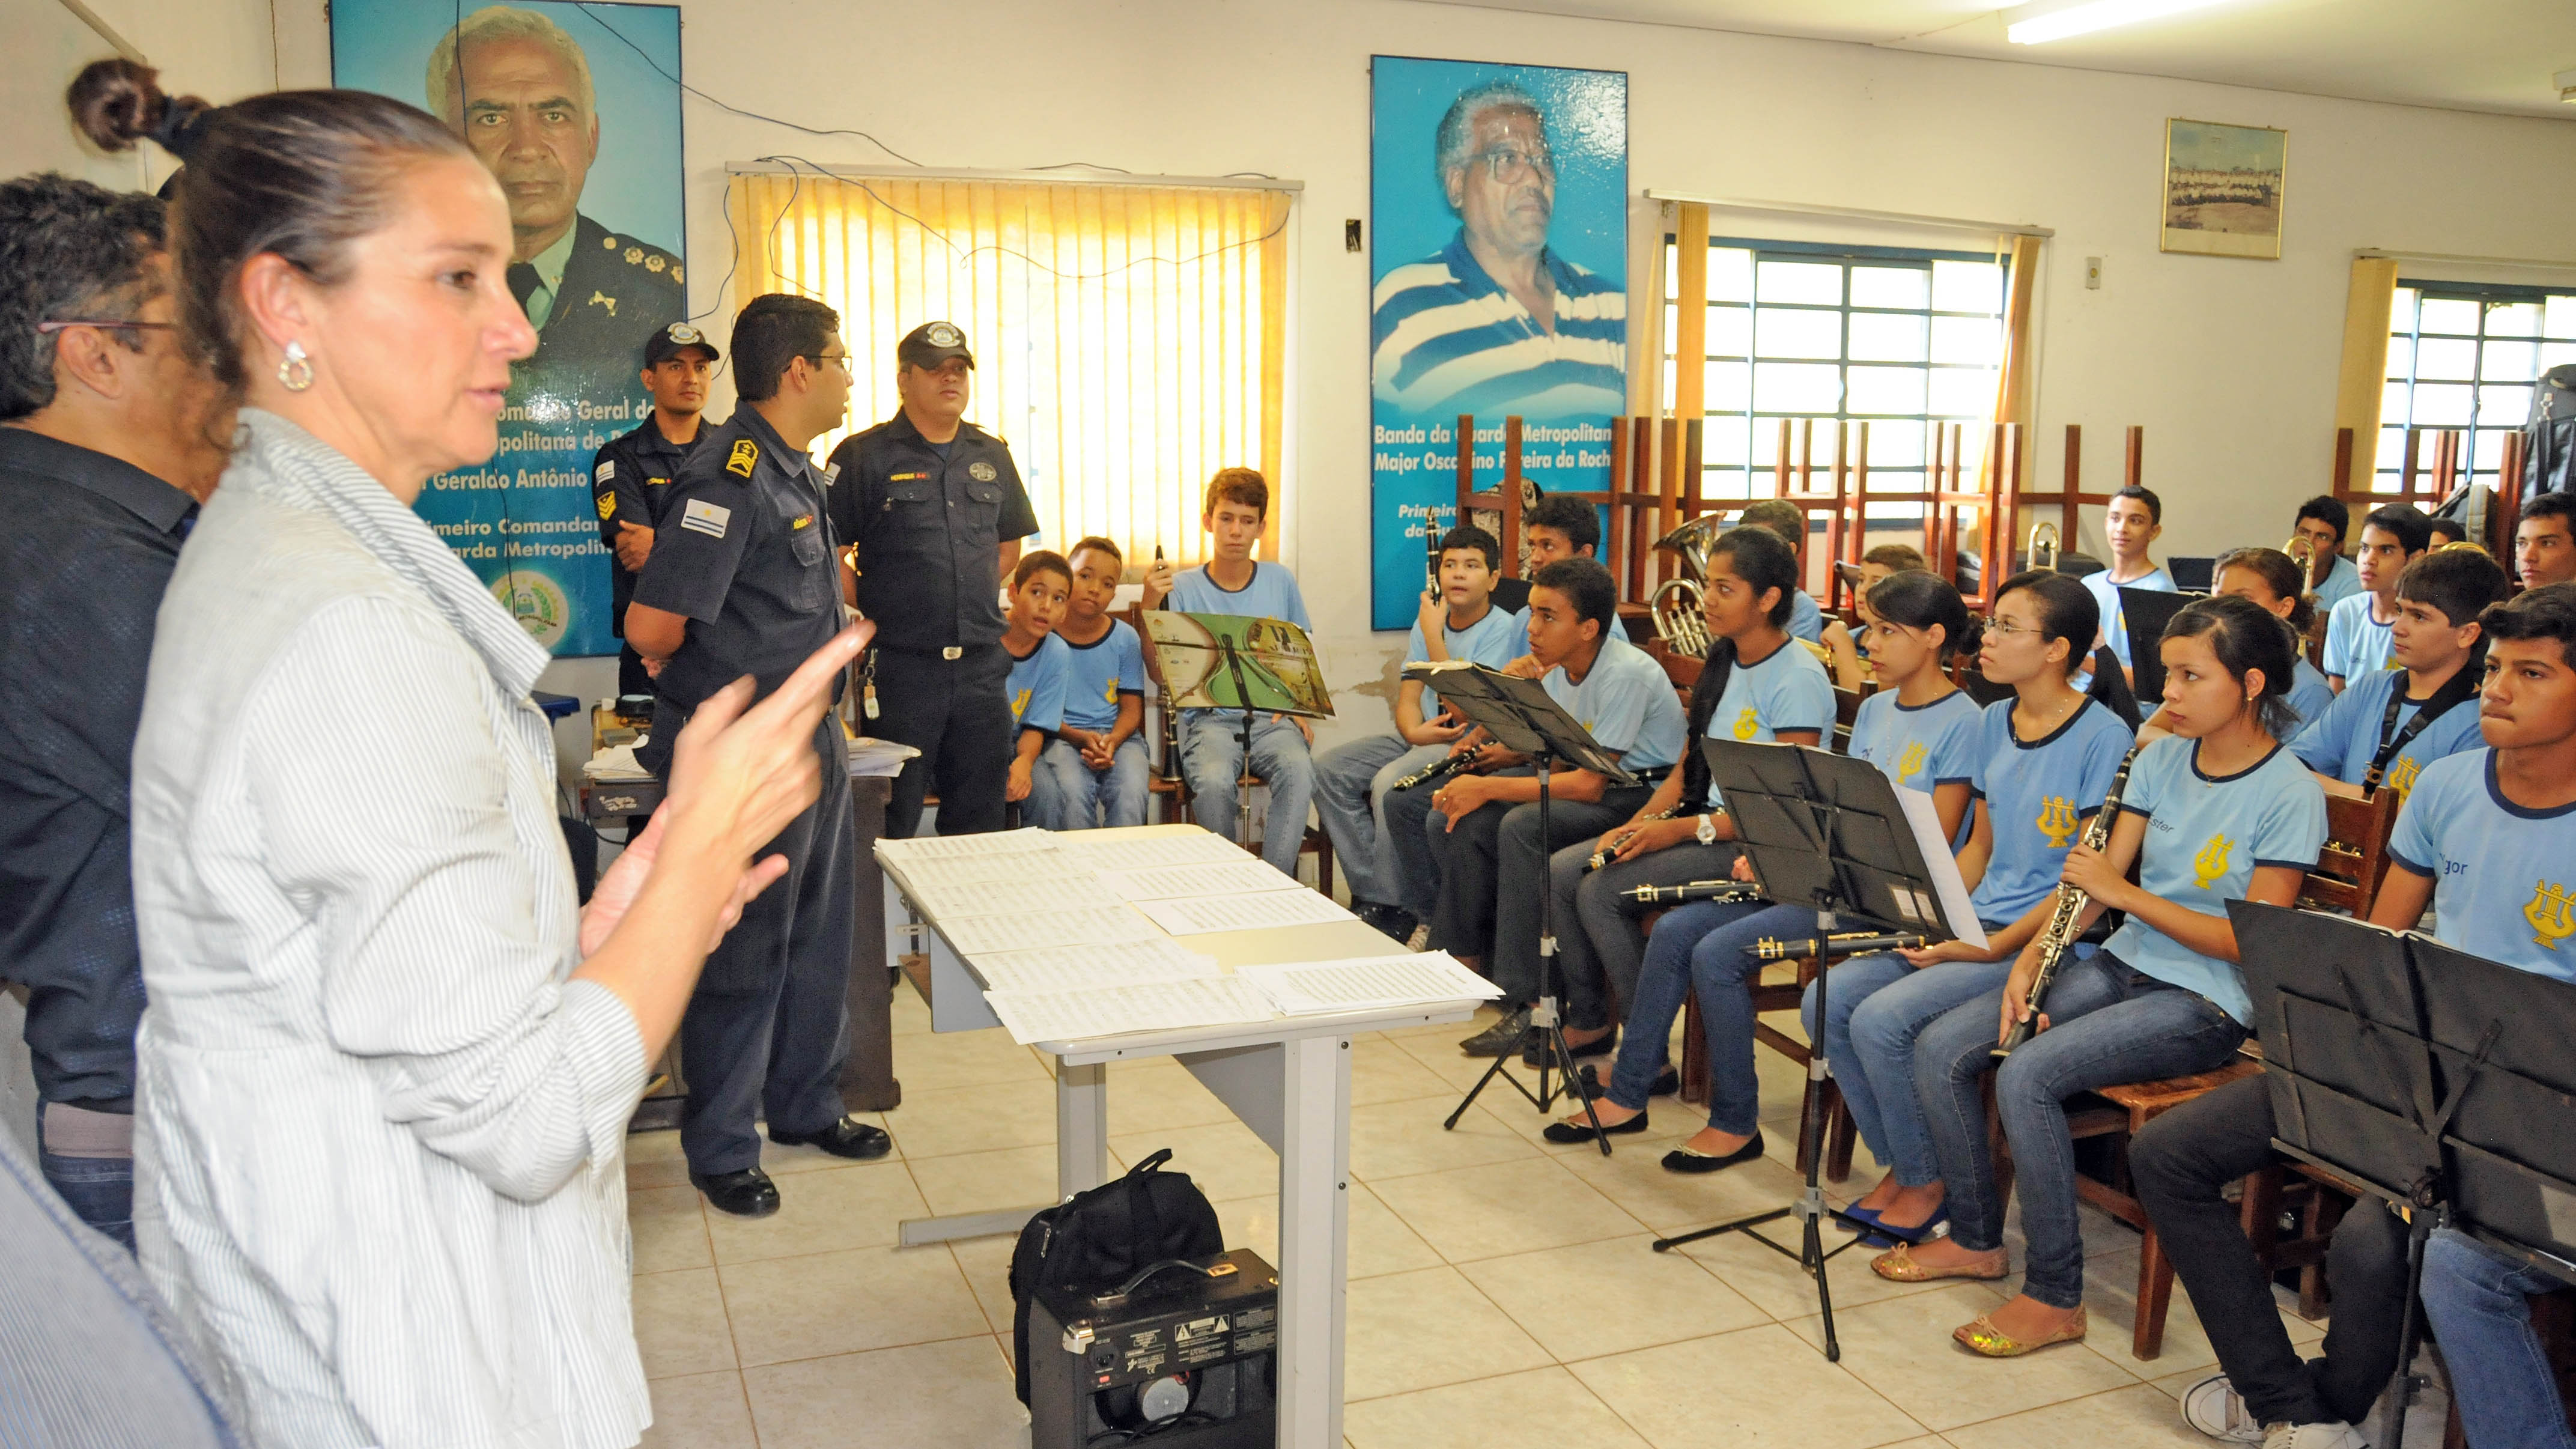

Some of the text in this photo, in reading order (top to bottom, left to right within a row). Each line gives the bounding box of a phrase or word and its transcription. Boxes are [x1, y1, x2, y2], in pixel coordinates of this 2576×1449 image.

[579, 399, 630, 420] Geral
[497, 430, 577, 457] politana
[582, 430, 606, 451] de
[1375, 422, 1612, 446] Banda da ard Metropolitan
[1375, 452, 1420, 475] Major
[1556, 450, 1575, 468] da
[1578, 449, 1611, 467] Roch
[433, 469, 510, 490] Geraldo
[515, 467, 588, 488] Antônio
[426, 519, 491, 536] meiro
[1405, 523, 1424, 538] da
[452, 539, 612, 559] arda Metropolit
